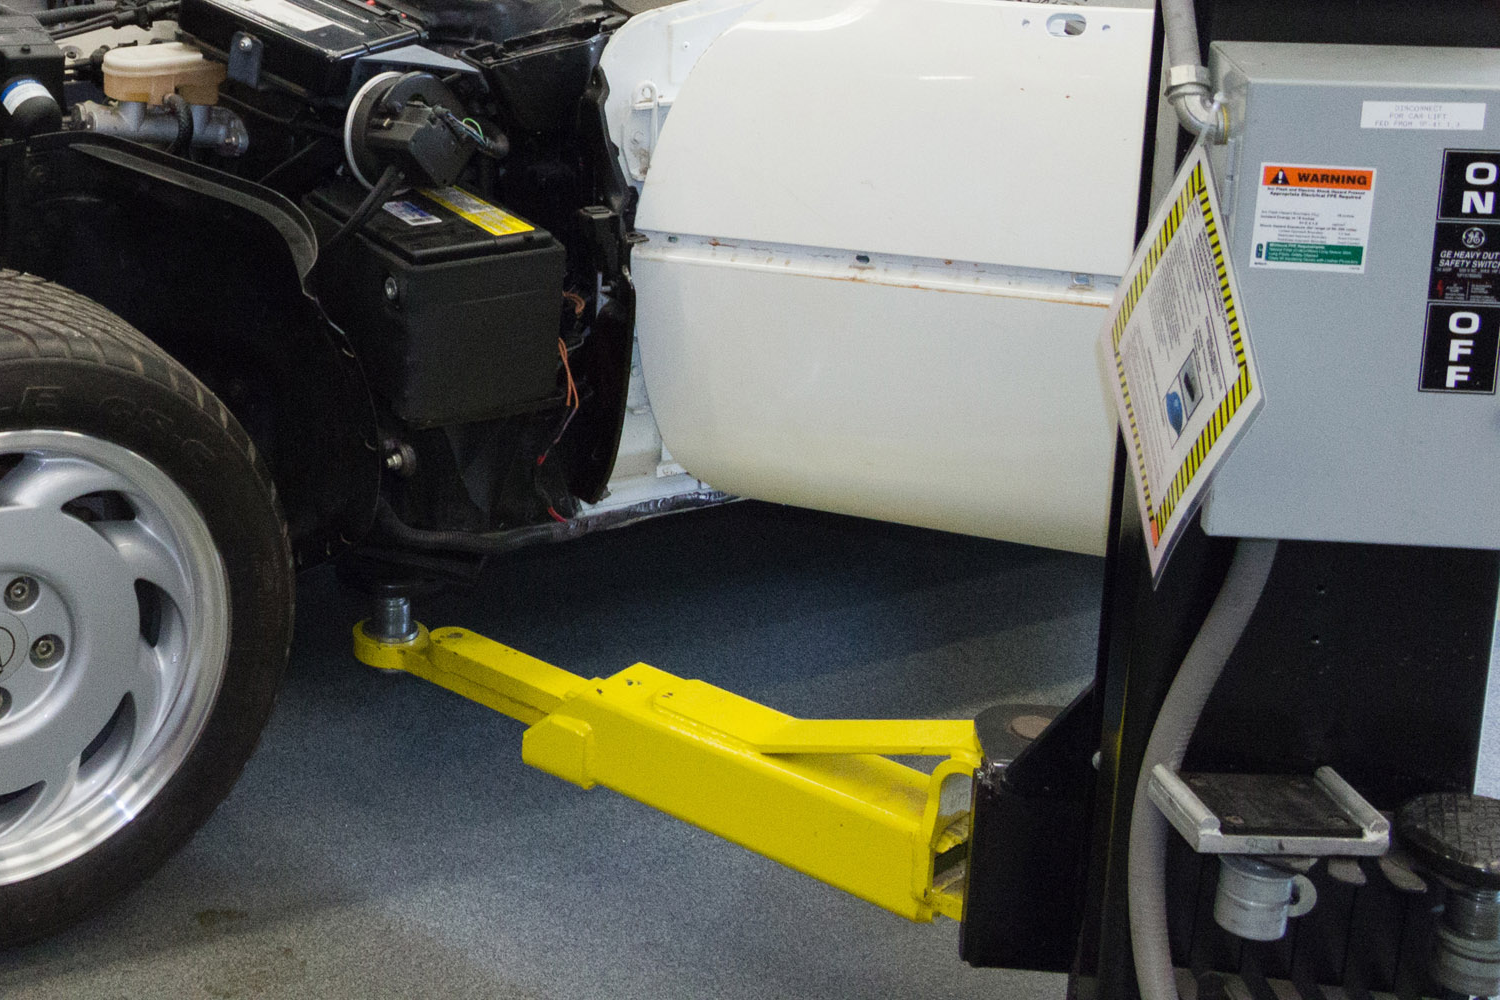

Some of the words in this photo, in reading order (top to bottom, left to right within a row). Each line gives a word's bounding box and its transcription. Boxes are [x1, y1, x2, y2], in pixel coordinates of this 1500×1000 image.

[1297, 172, 1367, 186] WARNING
[1461, 161, 1498, 214] ON
[1440, 250, 1453, 258] GE
[1453, 251, 1481, 259] HEAVY
[1439, 259, 1471, 268] SAFETY
[1445, 311, 1481, 388] OFF
